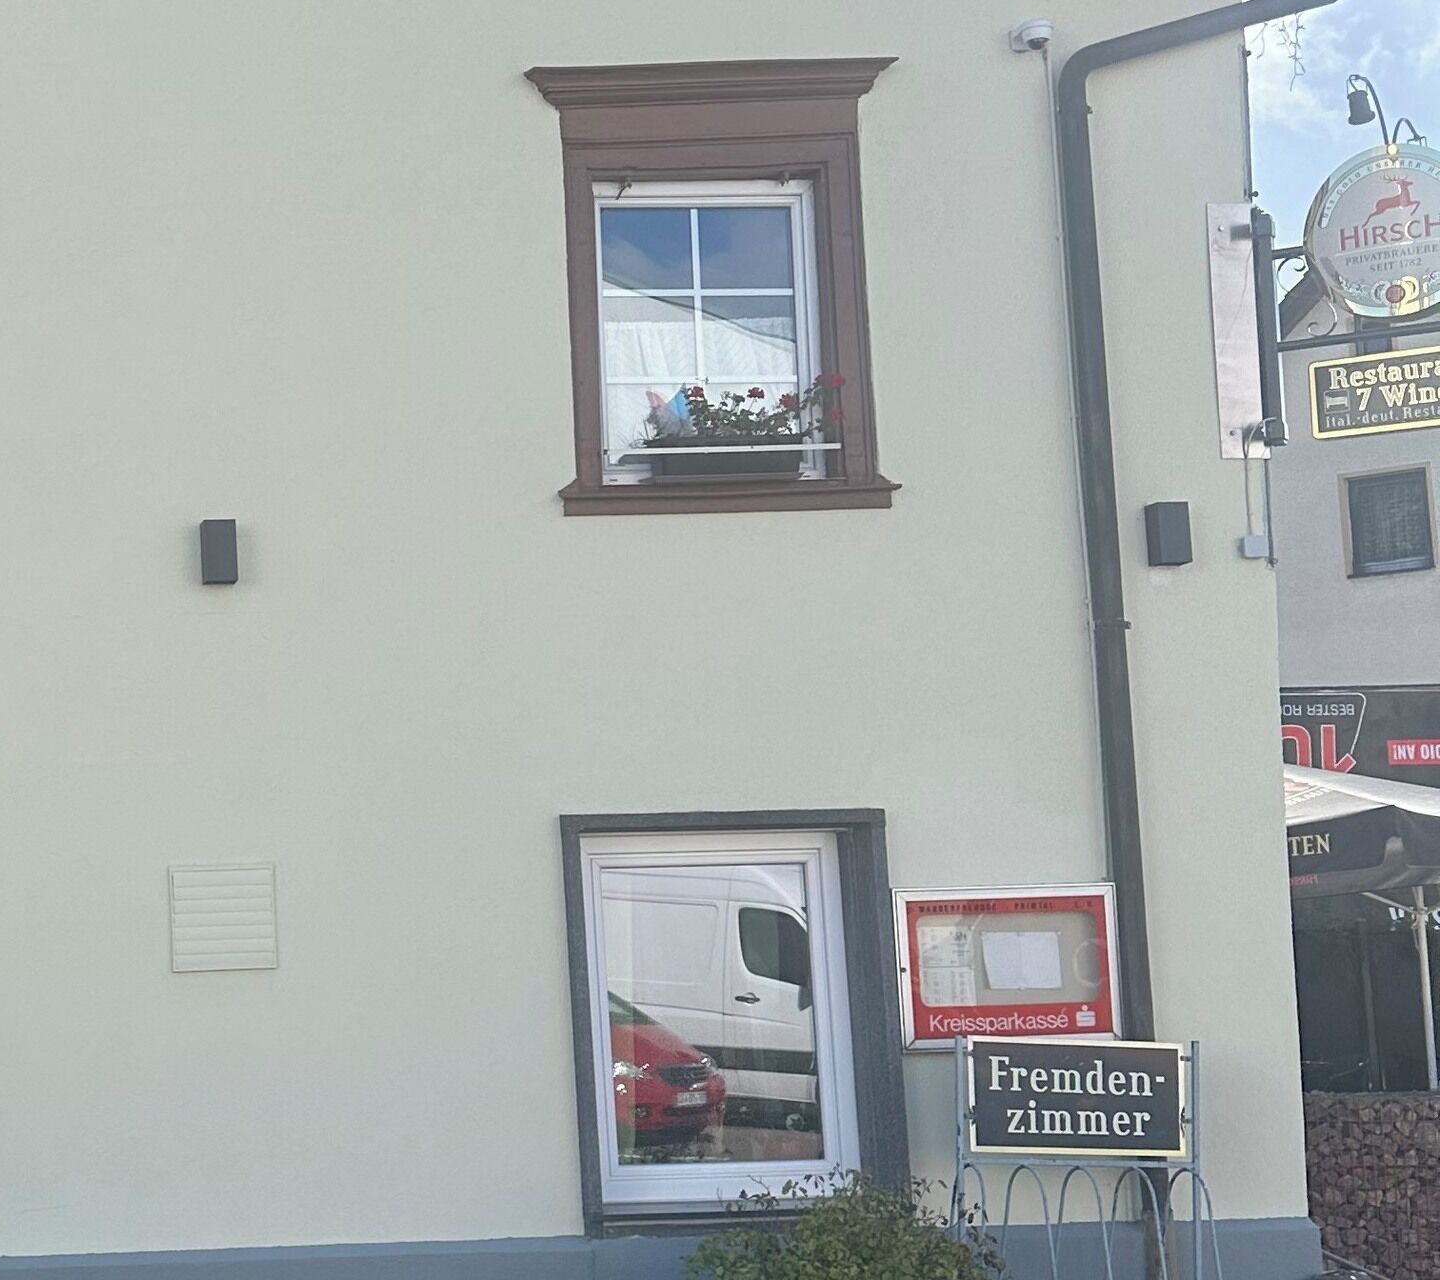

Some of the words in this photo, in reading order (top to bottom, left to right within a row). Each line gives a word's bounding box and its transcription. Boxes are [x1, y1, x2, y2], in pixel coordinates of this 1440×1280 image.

[1356, 387, 1372, 411] 7
[1379, 383, 1440, 408] Win
[1280, 703, 1302, 716] RO
[1307, 703, 1355, 716] BESTER
[1393, 744, 1416, 760] AN!
[930, 1012, 1068, 1034] Kreissparkasse
[988, 1056, 1165, 1096] Fremden-
[1007, 1100, 1151, 1136] zimmer
